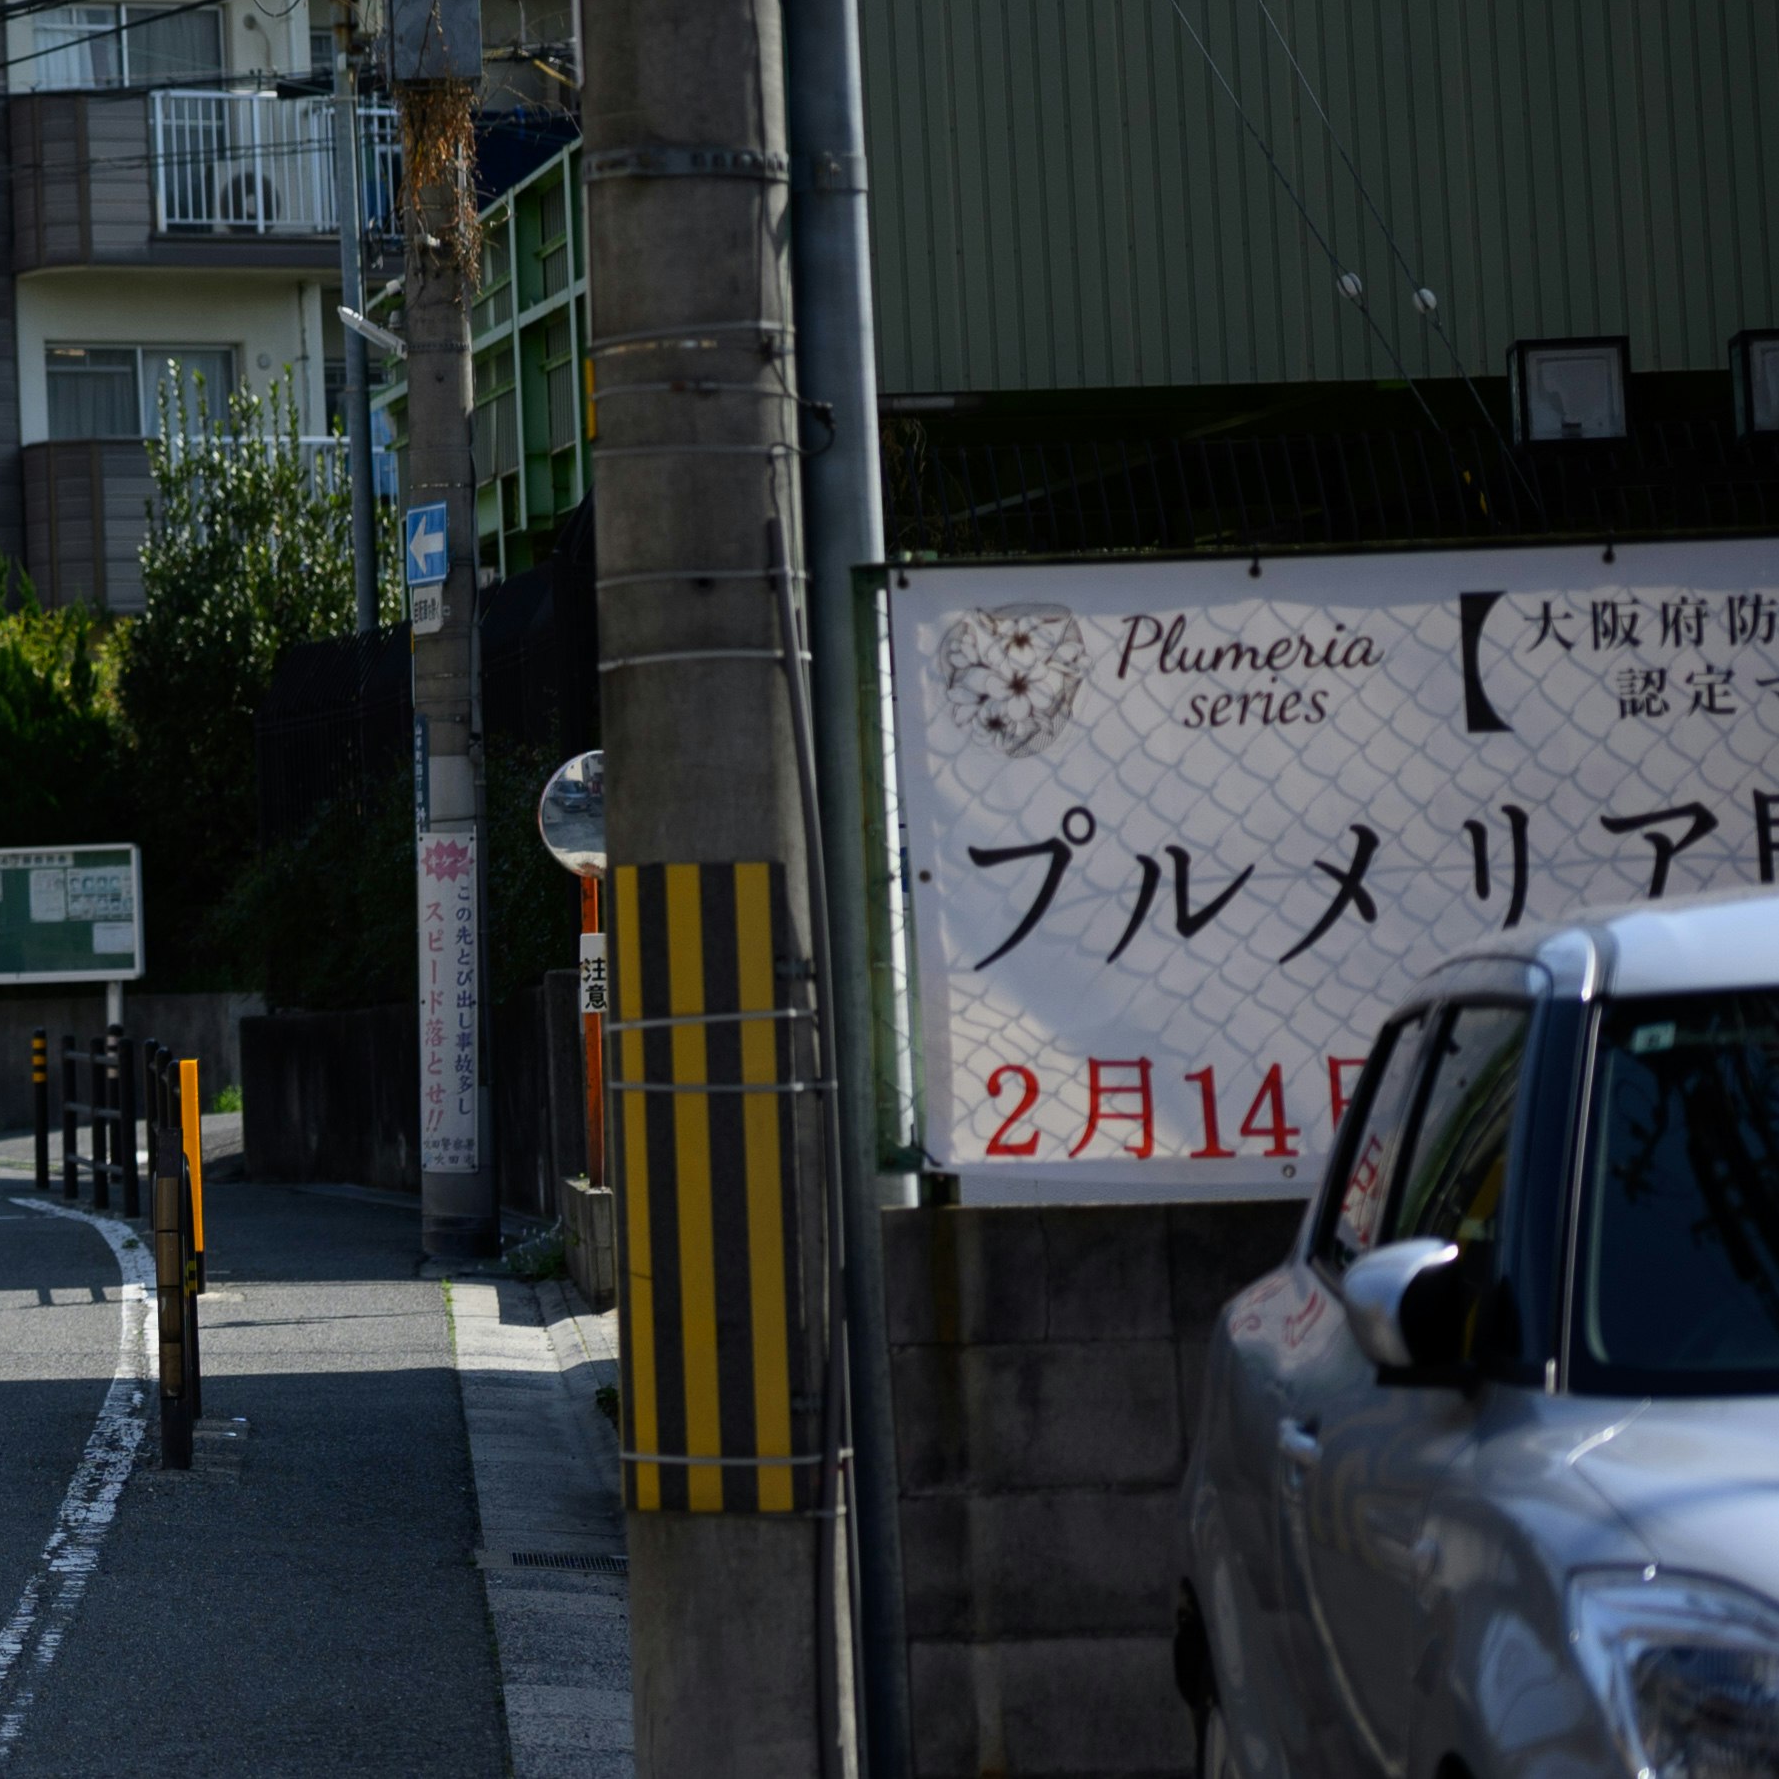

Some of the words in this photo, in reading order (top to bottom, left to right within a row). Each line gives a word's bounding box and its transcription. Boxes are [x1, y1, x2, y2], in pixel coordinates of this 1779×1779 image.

[1115, 612, 1384, 681] Plumeria
[1183, 678, 1329, 726] series
[427, 854, 467, 869] キケン
[967, 787, 1779, 972] プルメリア
[453, 886, 475, 1116] この先とび出し事故多し
[582, 956, 608, 1009] 注意
[424, 901, 446, 1134] スピード落とせ!!
